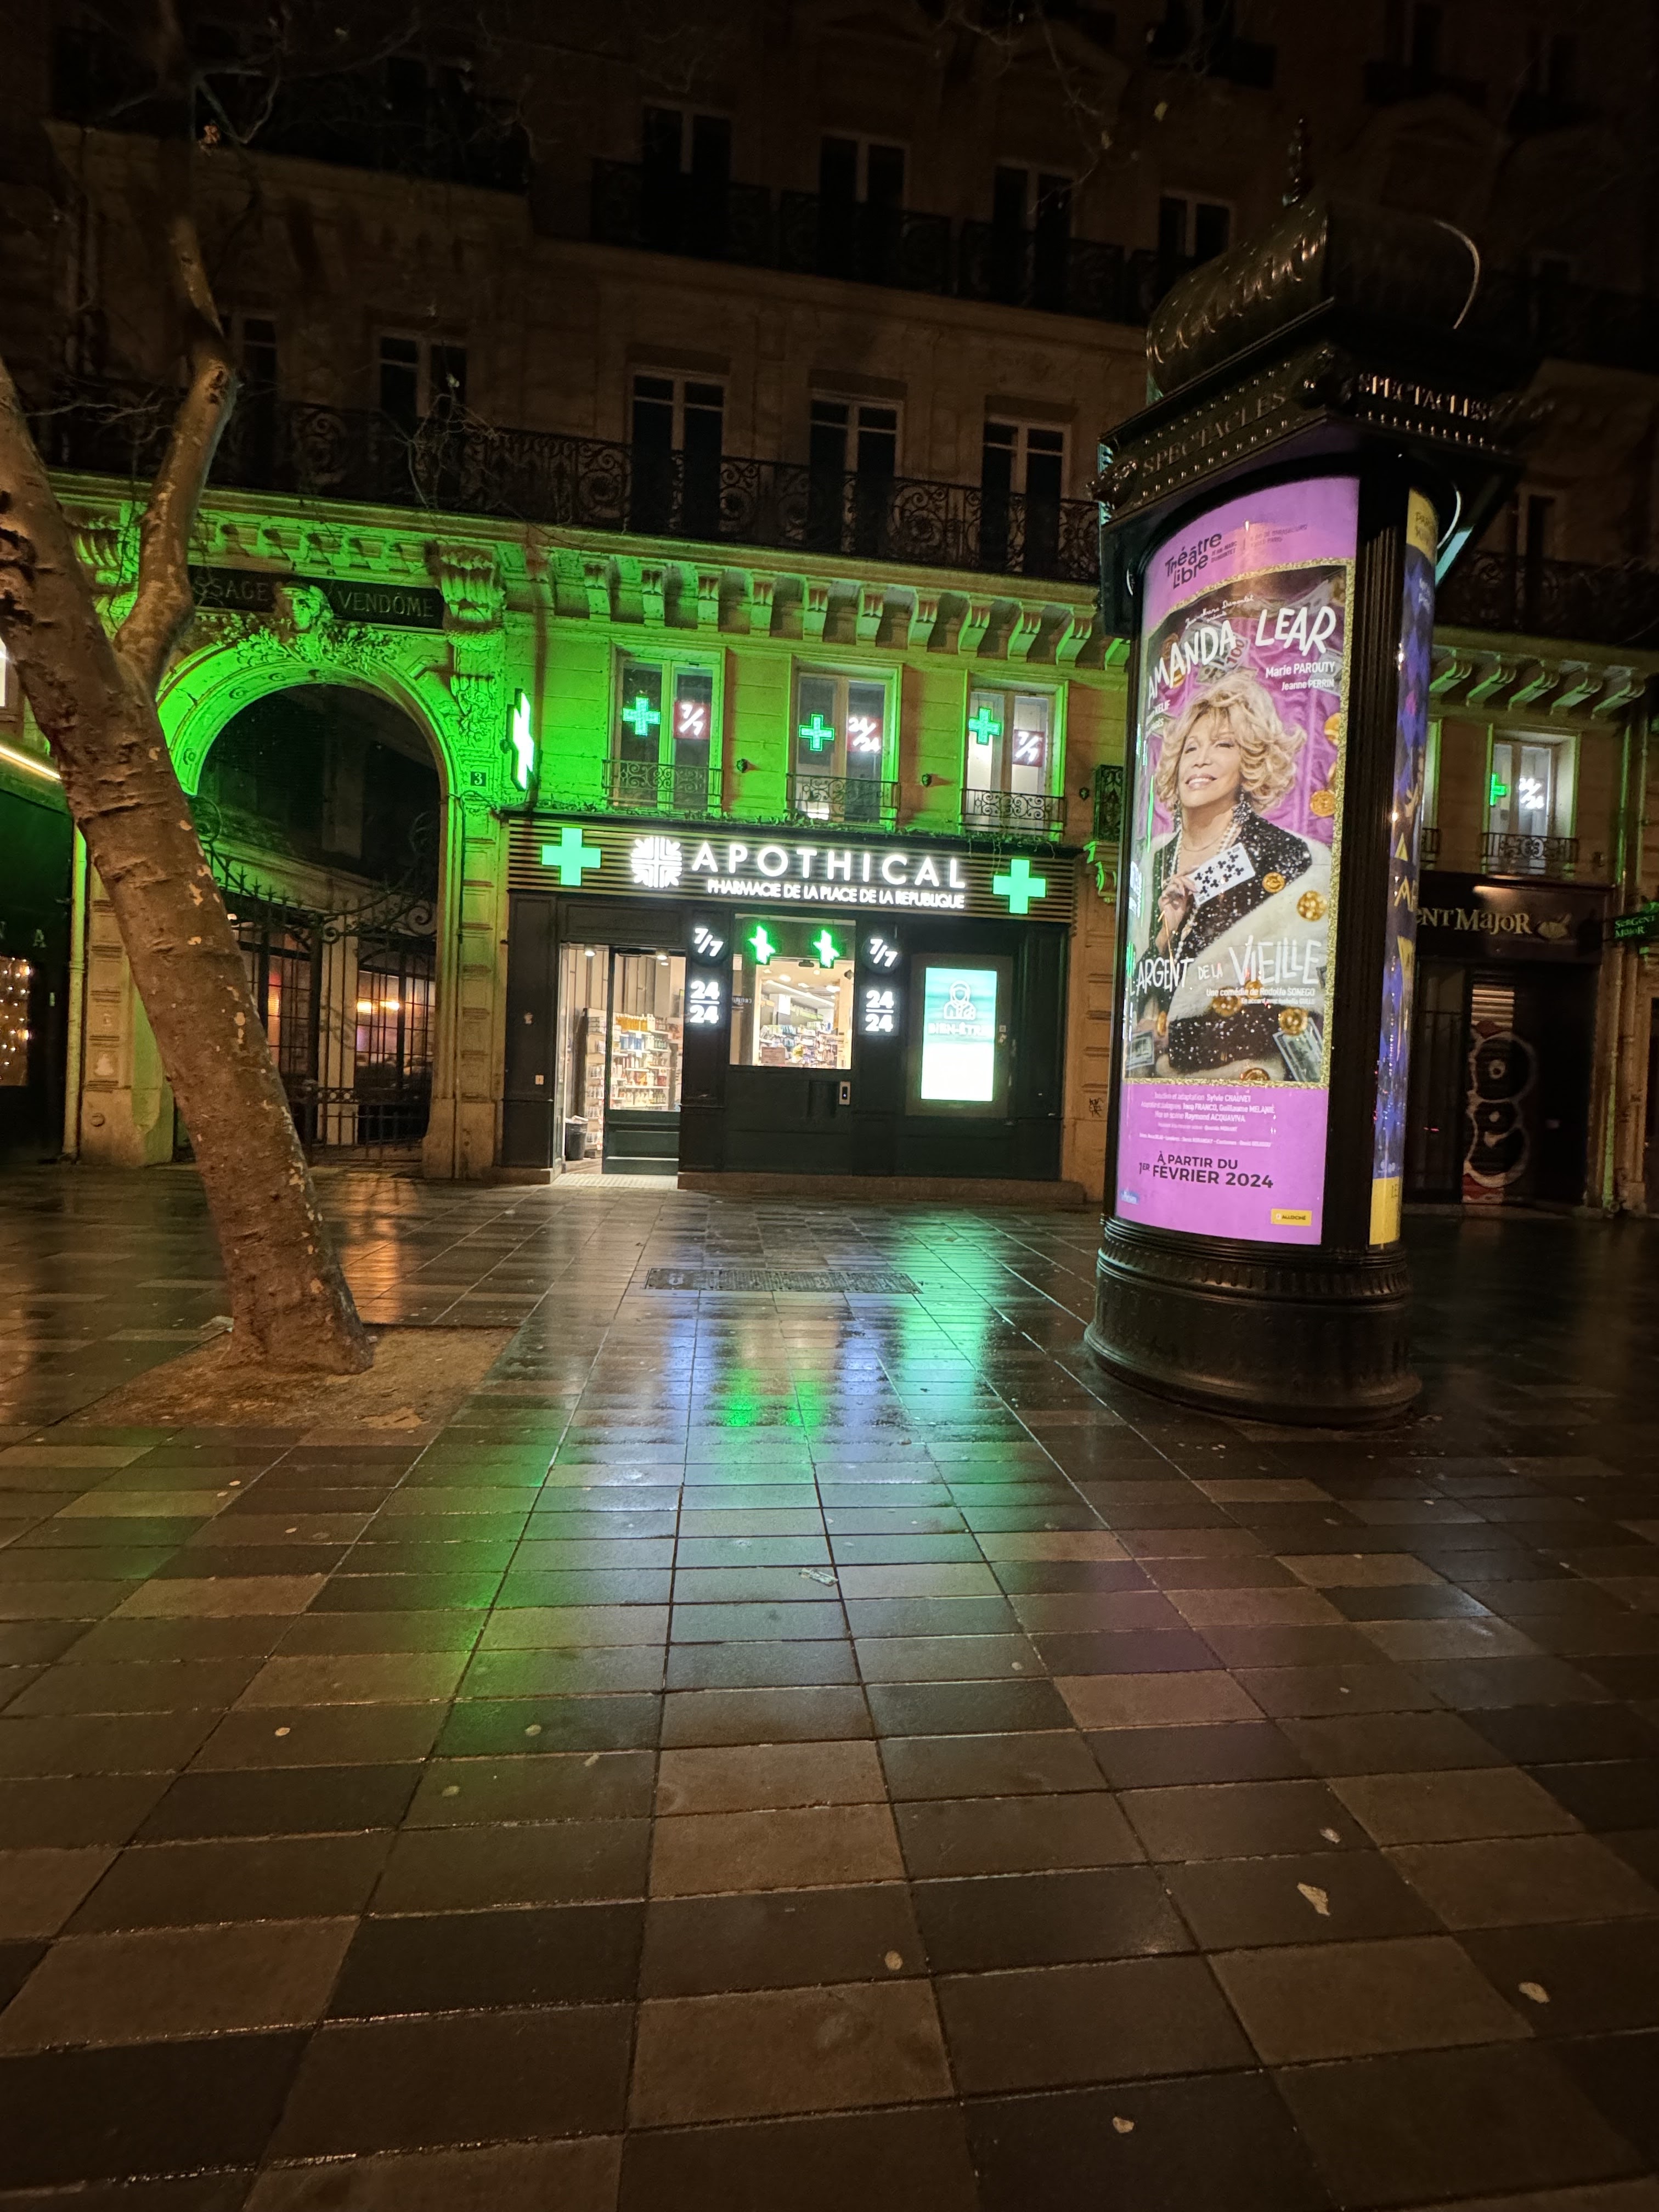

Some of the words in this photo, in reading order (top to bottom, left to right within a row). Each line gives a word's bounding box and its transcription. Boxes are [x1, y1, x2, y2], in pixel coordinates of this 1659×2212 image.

[1173, 554, 1209, 589] Libre
[337, 590, 435, 618] VENDÔME
[1148, 620, 1236, 710] AMANDA
[1255, 606, 1336, 656] LEAR
[1265, 666, 1291, 679] Marie
[1293, 661, 1335, 675] PAROUTY
[1281, 681, 1307, 691] Jeanne
[1307, 679, 1334, 689] PERRIN
[474, 772, 483, 785] 3
[691, 840, 966, 889] APOTHICAL
[707, 879, 782, 898] PHARMACIE
[783, 884, 801, 899] DE
[803, 885, 819, 900] LA
[820, 887, 857, 902] PLACE
[860, 889, 877, 904] DE
[879, 890, 895, 905] LA
[693, 927, 723, 957] 7/7
[869, 938, 899, 967] 7/7
[1198, 965, 1210, 981] DE
[1211, 963, 1223, 979] LA
[1228, 934, 1322, 986] VIEILLE
[690, 980, 720, 1000] 24
[866, 990, 894, 1009] 24
[1206, 988, 1218, 997] Une
[1220, 988, 1248, 996] comédie
[689, 1004, 719, 1024] 24
[865, 1013, 894, 1032] 24
[1158, 1151, 1165, 1163] À
[1167, 1154, 1213, 1168] PARTIR
[1217, 1159, 1238, 1170] DU
[1153, 1163, 1220, 1184] FÉVRIER
[1225, 1172, 1274, 1188] 2024
